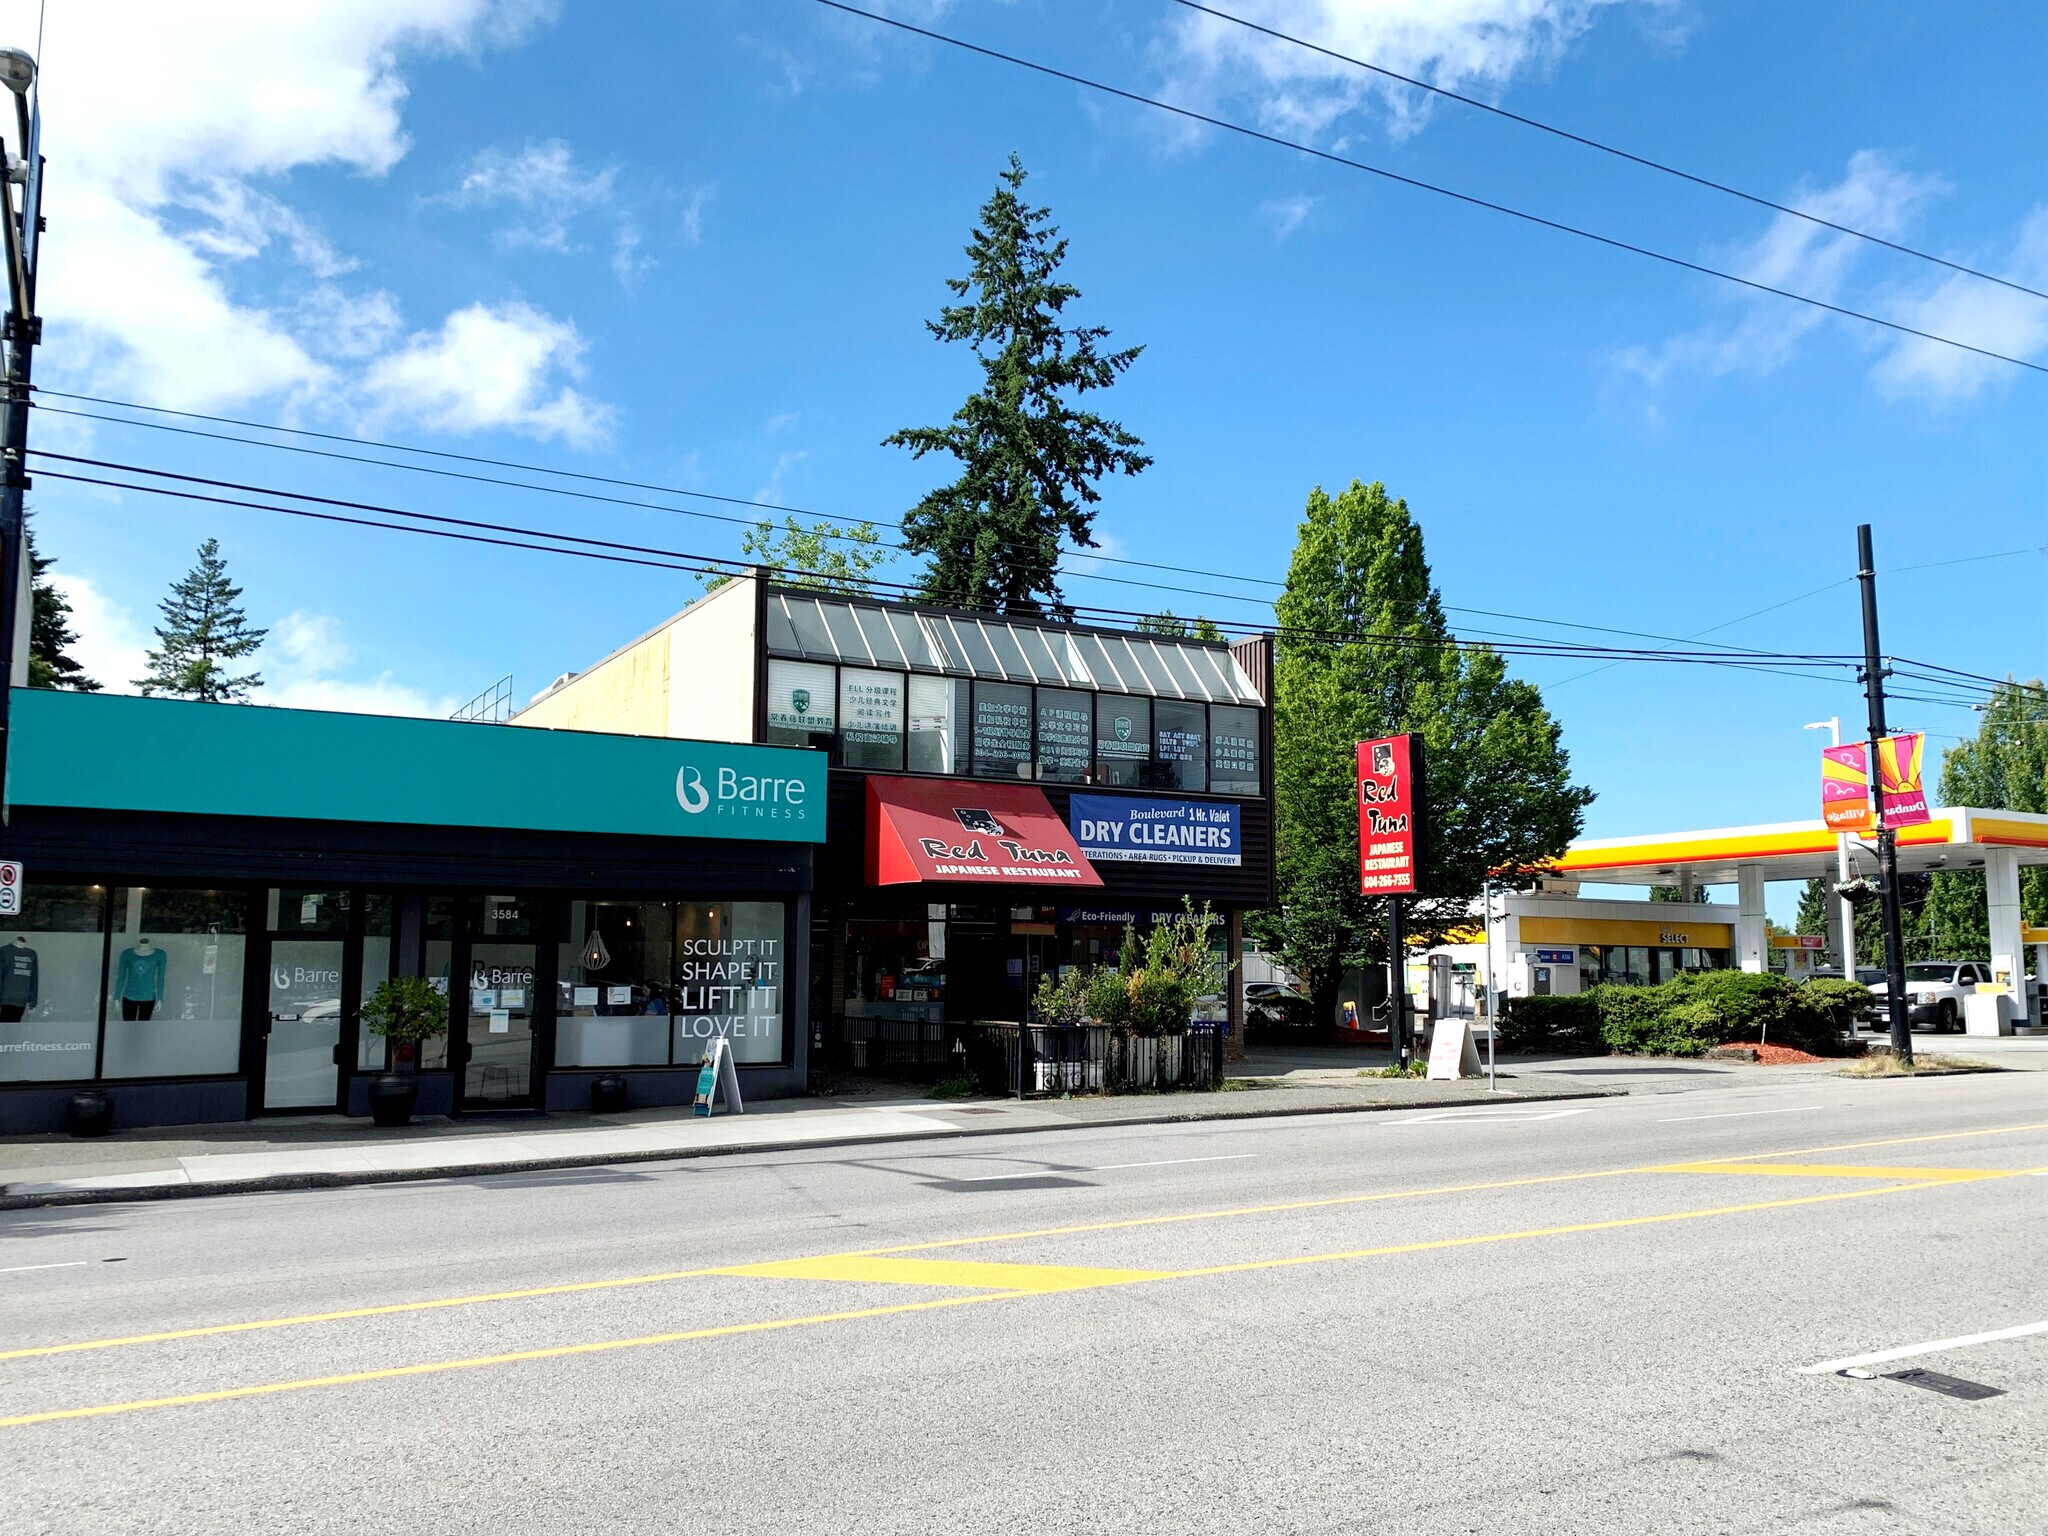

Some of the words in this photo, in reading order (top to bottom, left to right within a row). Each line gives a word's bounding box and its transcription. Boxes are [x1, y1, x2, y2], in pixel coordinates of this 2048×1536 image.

[848, 684, 863, 693] ELL
[866, 685, 897, 696] 分级课程
[849, 696, 897, 707] 少儿经典文学
[857, 708, 892, 718] 阅读写作
[718, 767, 805, 805] Barre
[1362, 775, 1398, 805] Red
[717, 804, 806, 820] FITNESS
[1130, 807, 1185, 820] Boulevard
[1189, 809, 1195, 821] 1
[1196, 808, 1208, 821] Hr.
[1209, 809, 1230, 823] Valet
[1367, 808, 1409, 836] Tuna
[1080, 820, 1124, 843] DRY
[1128, 822, 1231, 848] CLEANERS
[918, 838, 989, 862] Red
[997, 840, 1074, 864] Tuna
[1369, 841, 1404, 856] JAPANESE
[1081, 850, 1123, 860] TERATIONS
[1128, 852, 1147, 861] AREA
[1148, 853, 1168, 862] RUGS
[1172, 854, 1197, 864] PICKUP
[1204, 856, 1236, 865] DELIVERY
[1364, 856, 1410, 871] RESTAURANT
[935, 864, 1000, 876] JAPANESE
[1001, 866, 1082, 878] RESTAURANT
[491, 909, 519, 920] 3584
[1081, 911, 1136, 924] Eco-Friendly
[1151, 912, 1172, 924] DRY
[1661, 933, 1689, 944] SELECT
[683, 939, 756, 956] SCULPT
[760, 939, 777, 956] IT
[294, 967, 339, 983] Barre
[492, 969, 533, 984] Barre
[682, 961, 752, 980] SHAPE
[758, 961, 778, 980] IT
[682, 986, 742, 1009] LIFT
[750, 986, 777, 1009] IT
[681, 1016, 746, 1038] LOVE
[753, 1016, 776, 1037] IT
